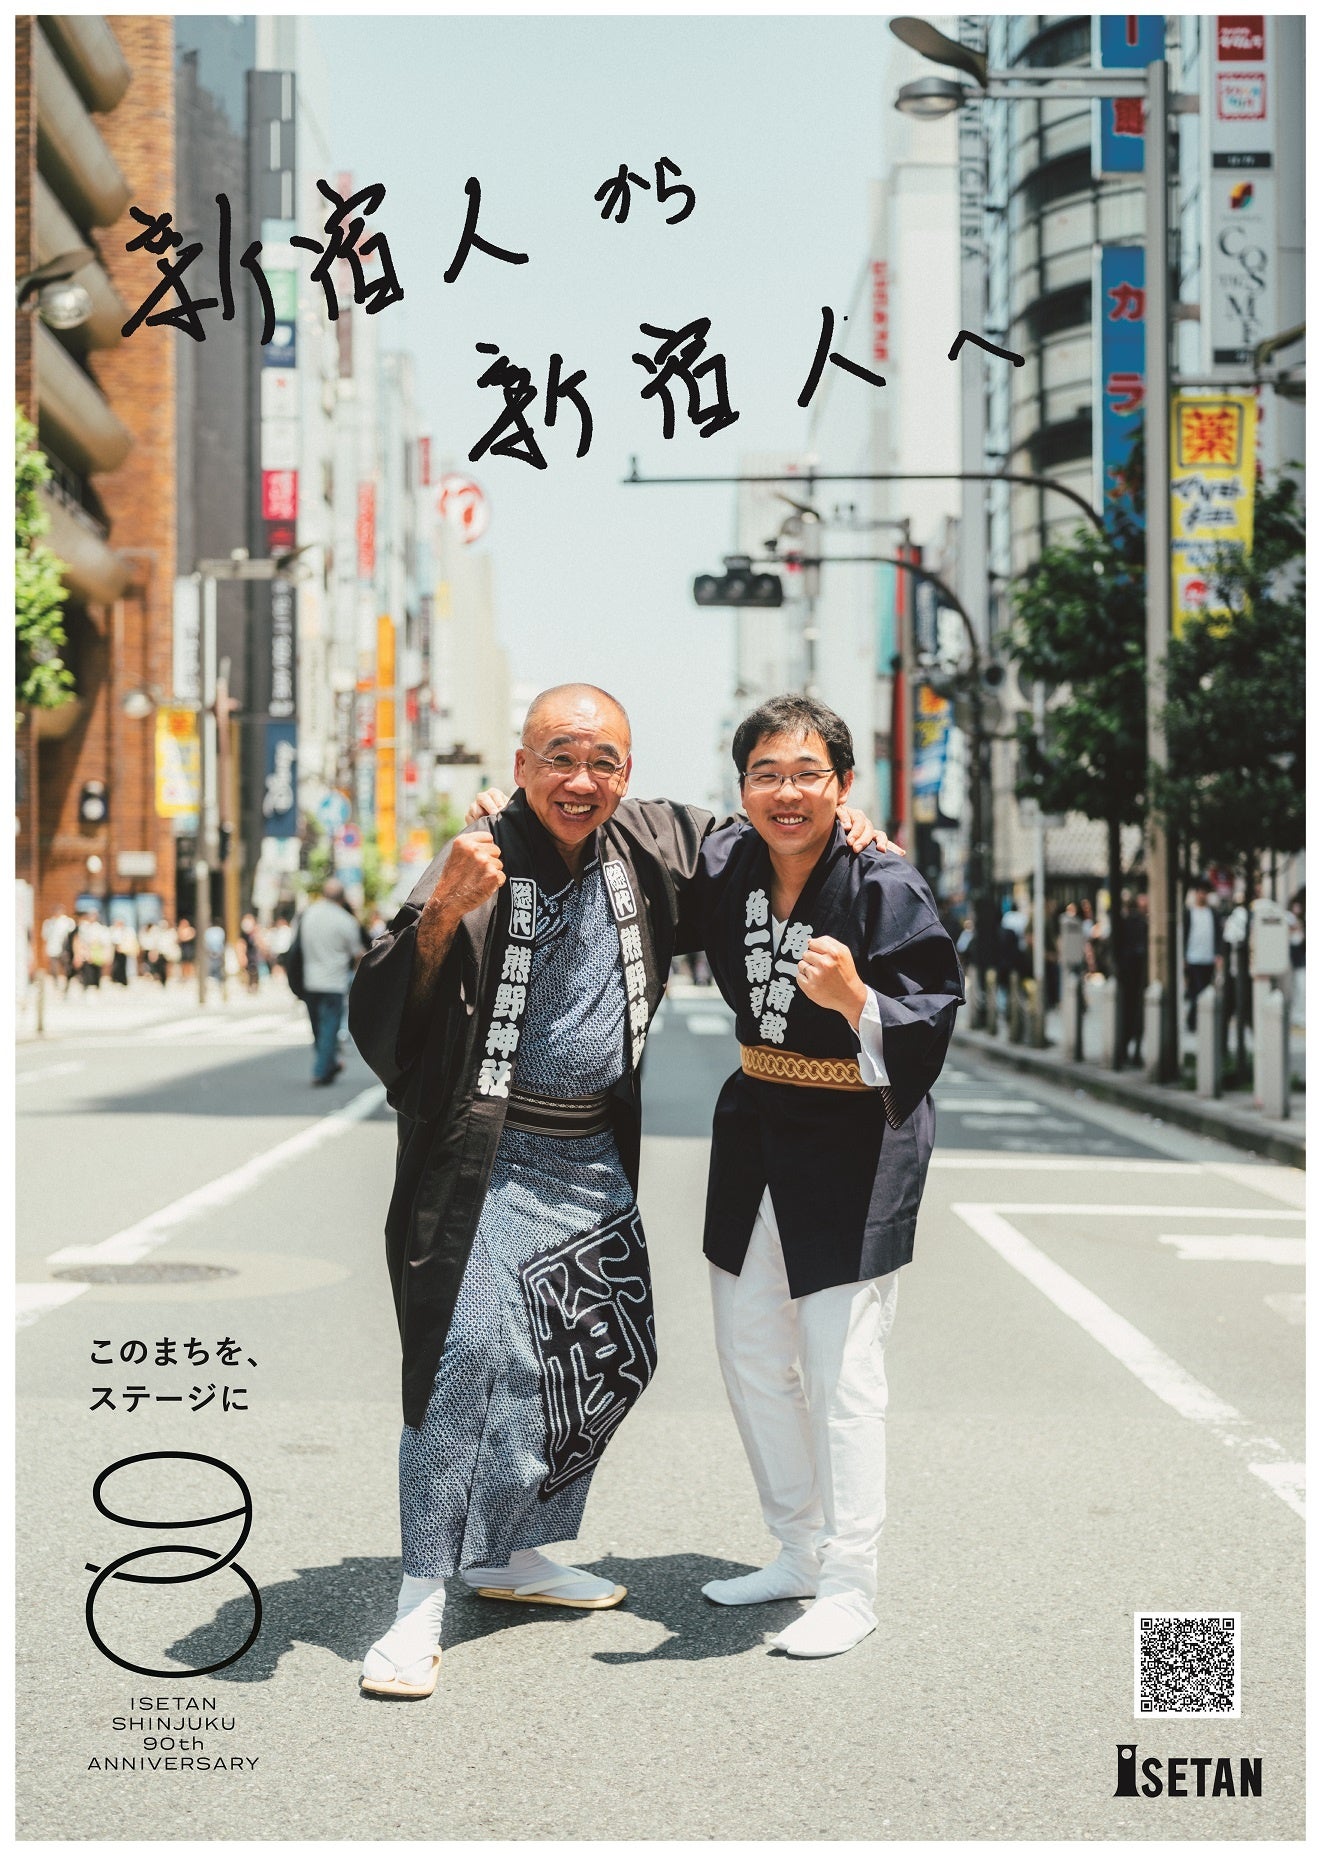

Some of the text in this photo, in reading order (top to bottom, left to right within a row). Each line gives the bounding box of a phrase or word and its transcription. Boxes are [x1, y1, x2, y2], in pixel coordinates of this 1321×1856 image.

[1183, 408, 1234, 464] 薬
[478, 944, 532, 1099] 熊野神社
